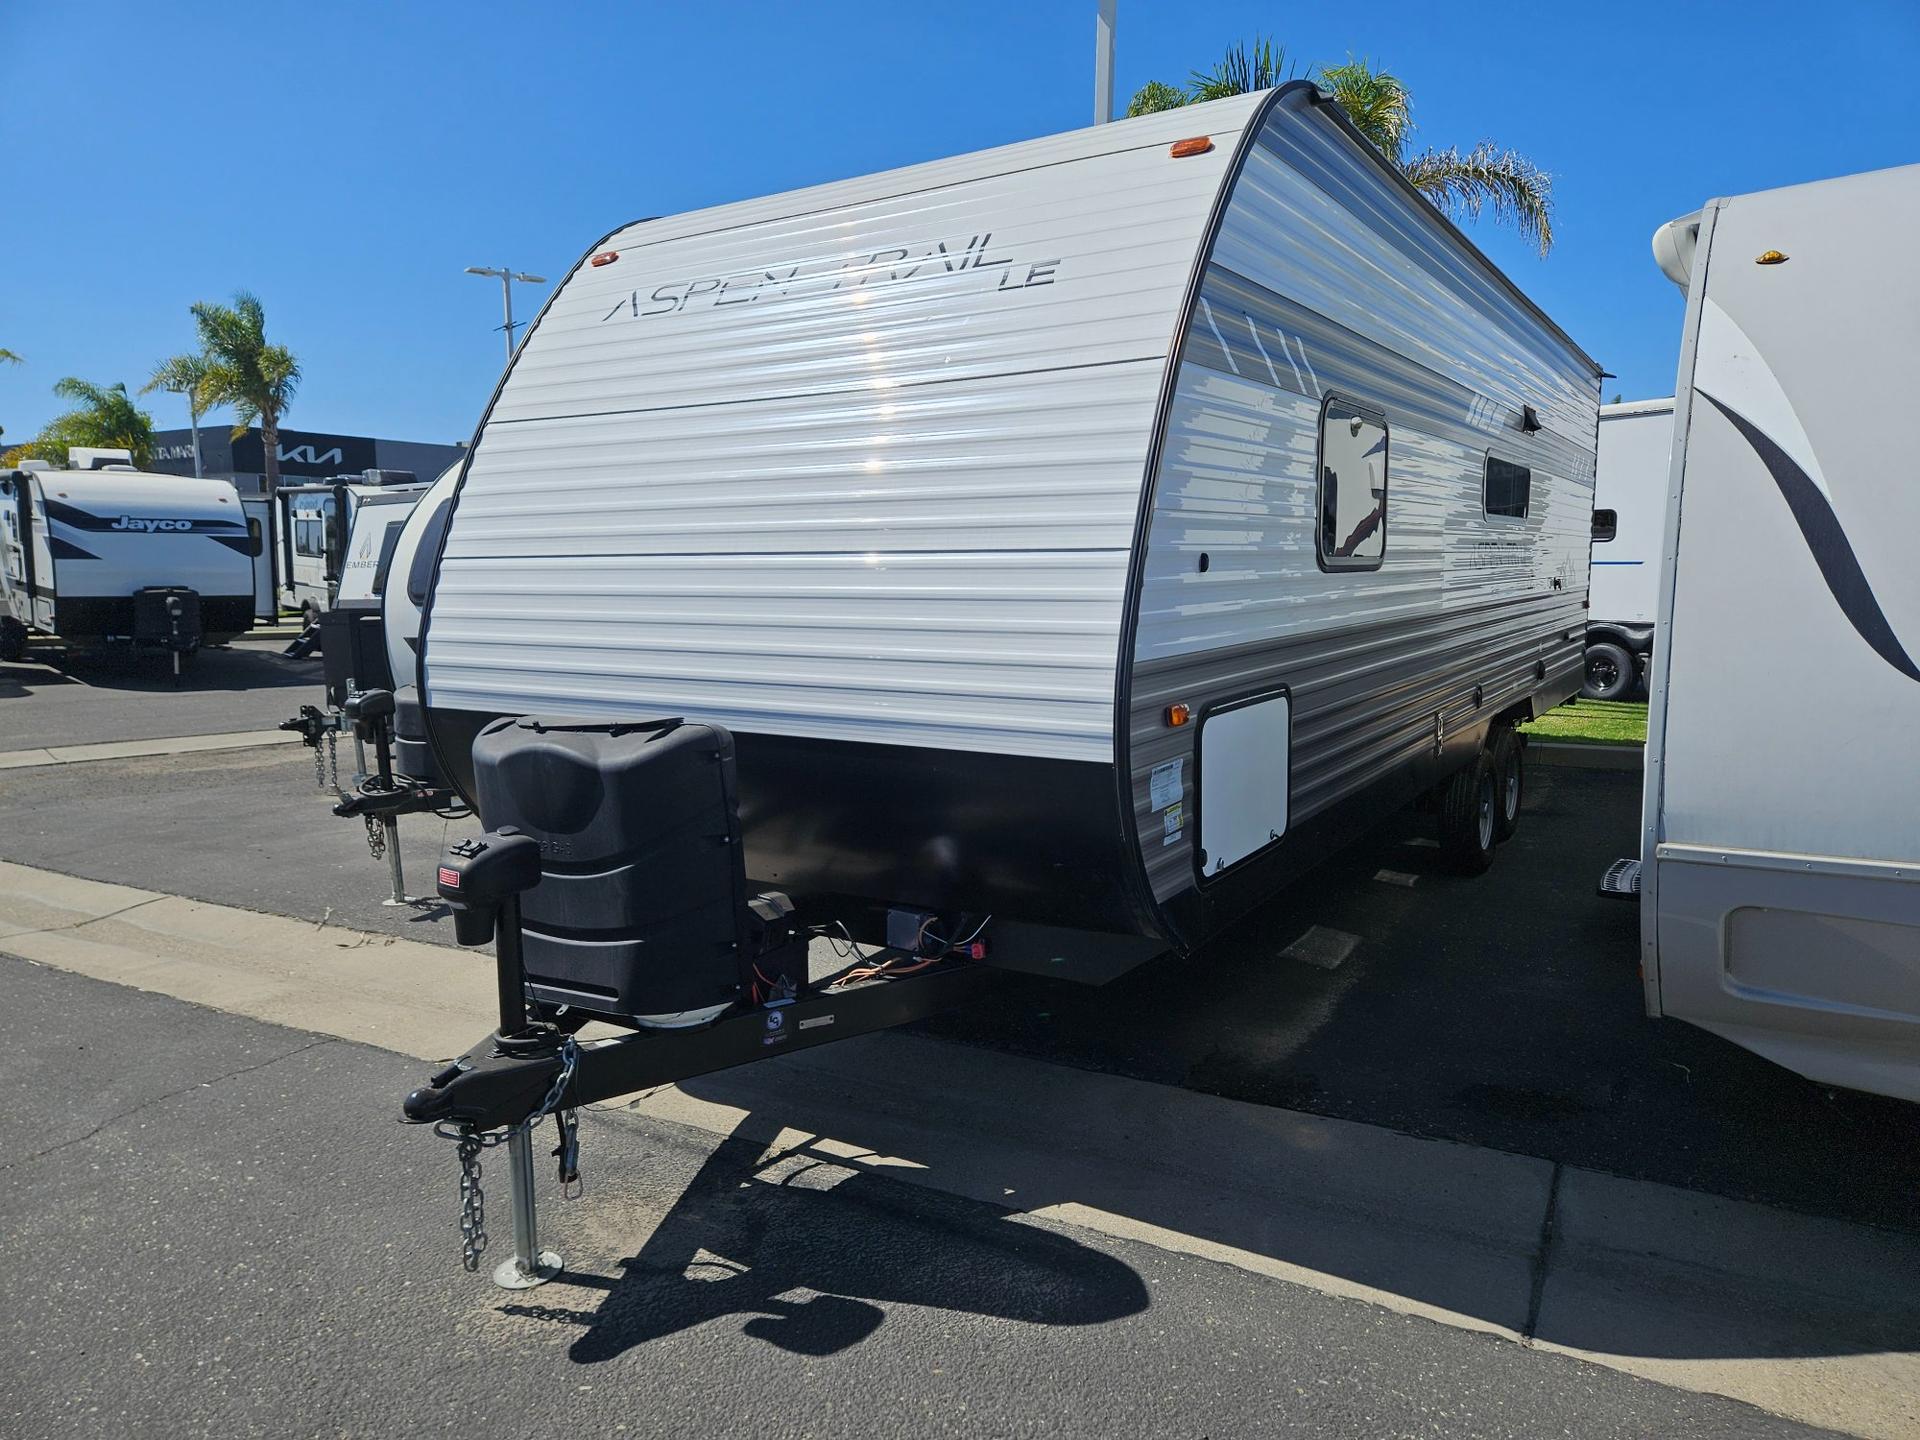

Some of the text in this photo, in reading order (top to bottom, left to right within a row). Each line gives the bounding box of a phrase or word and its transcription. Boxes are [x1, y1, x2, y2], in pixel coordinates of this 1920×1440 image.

[603, 232, 1061, 322] ASPEN TRAIL LE
[276, 443, 343, 465] KIA
[111, 514, 192, 533] Jayco
